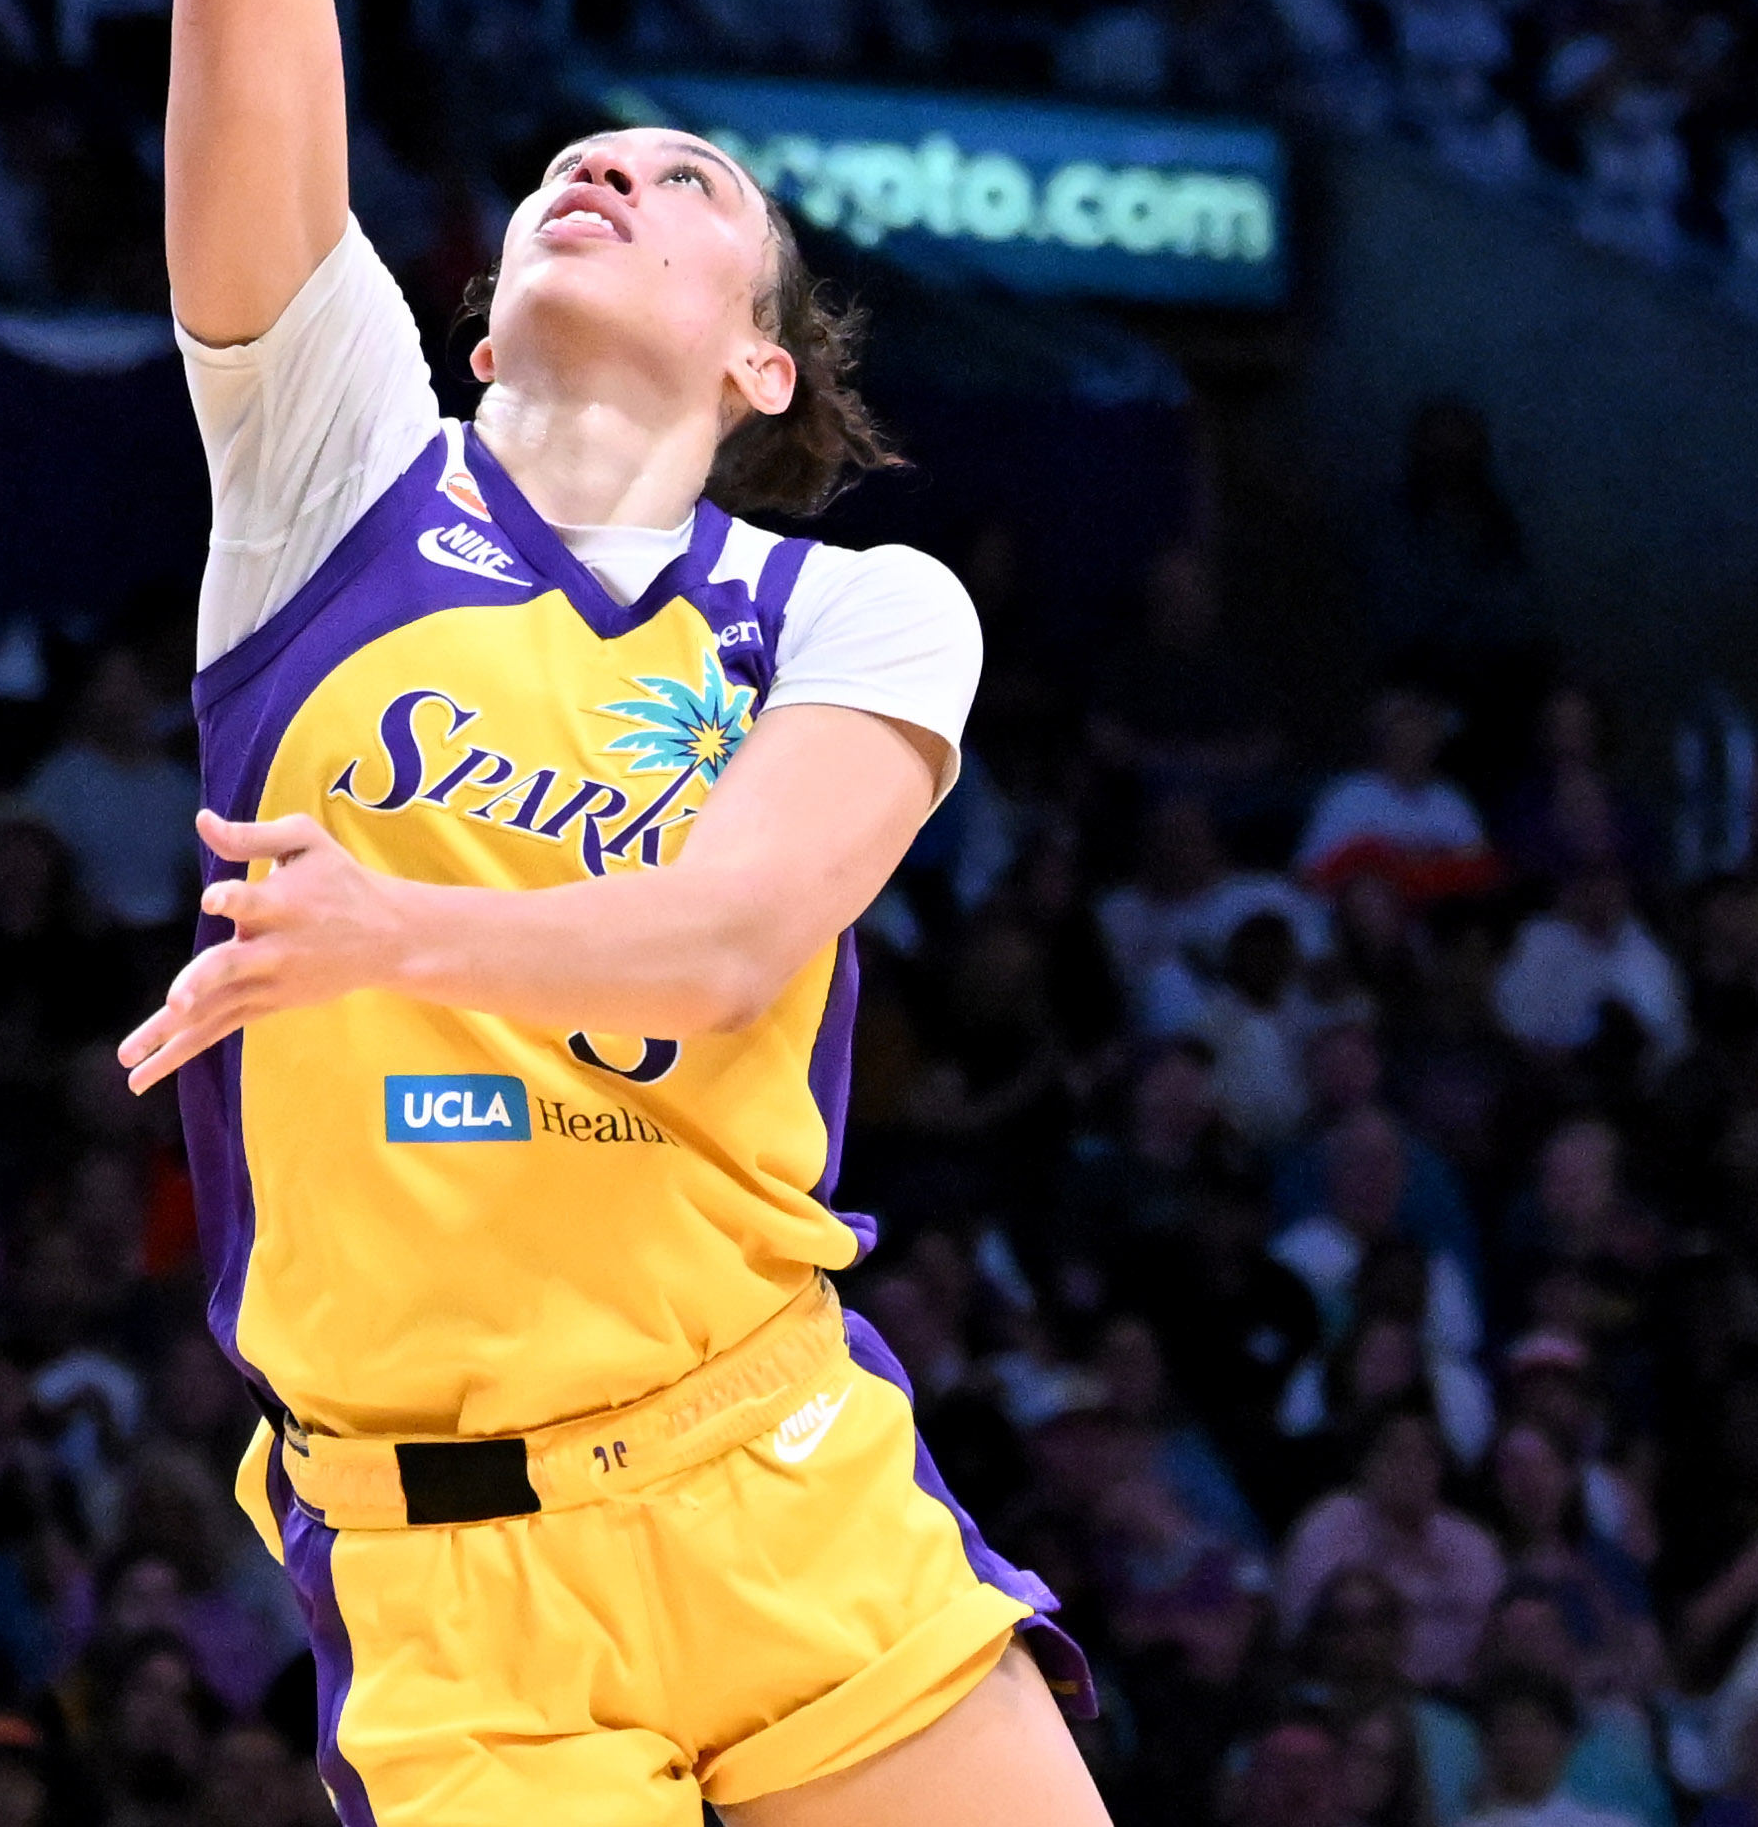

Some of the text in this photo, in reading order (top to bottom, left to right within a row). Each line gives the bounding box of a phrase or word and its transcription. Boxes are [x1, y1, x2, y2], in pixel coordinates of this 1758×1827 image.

[439, 522, 515, 572] NIKE
[328, 689, 701, 878] SPARK
[403, 1090, 513, 1129] UCLA
